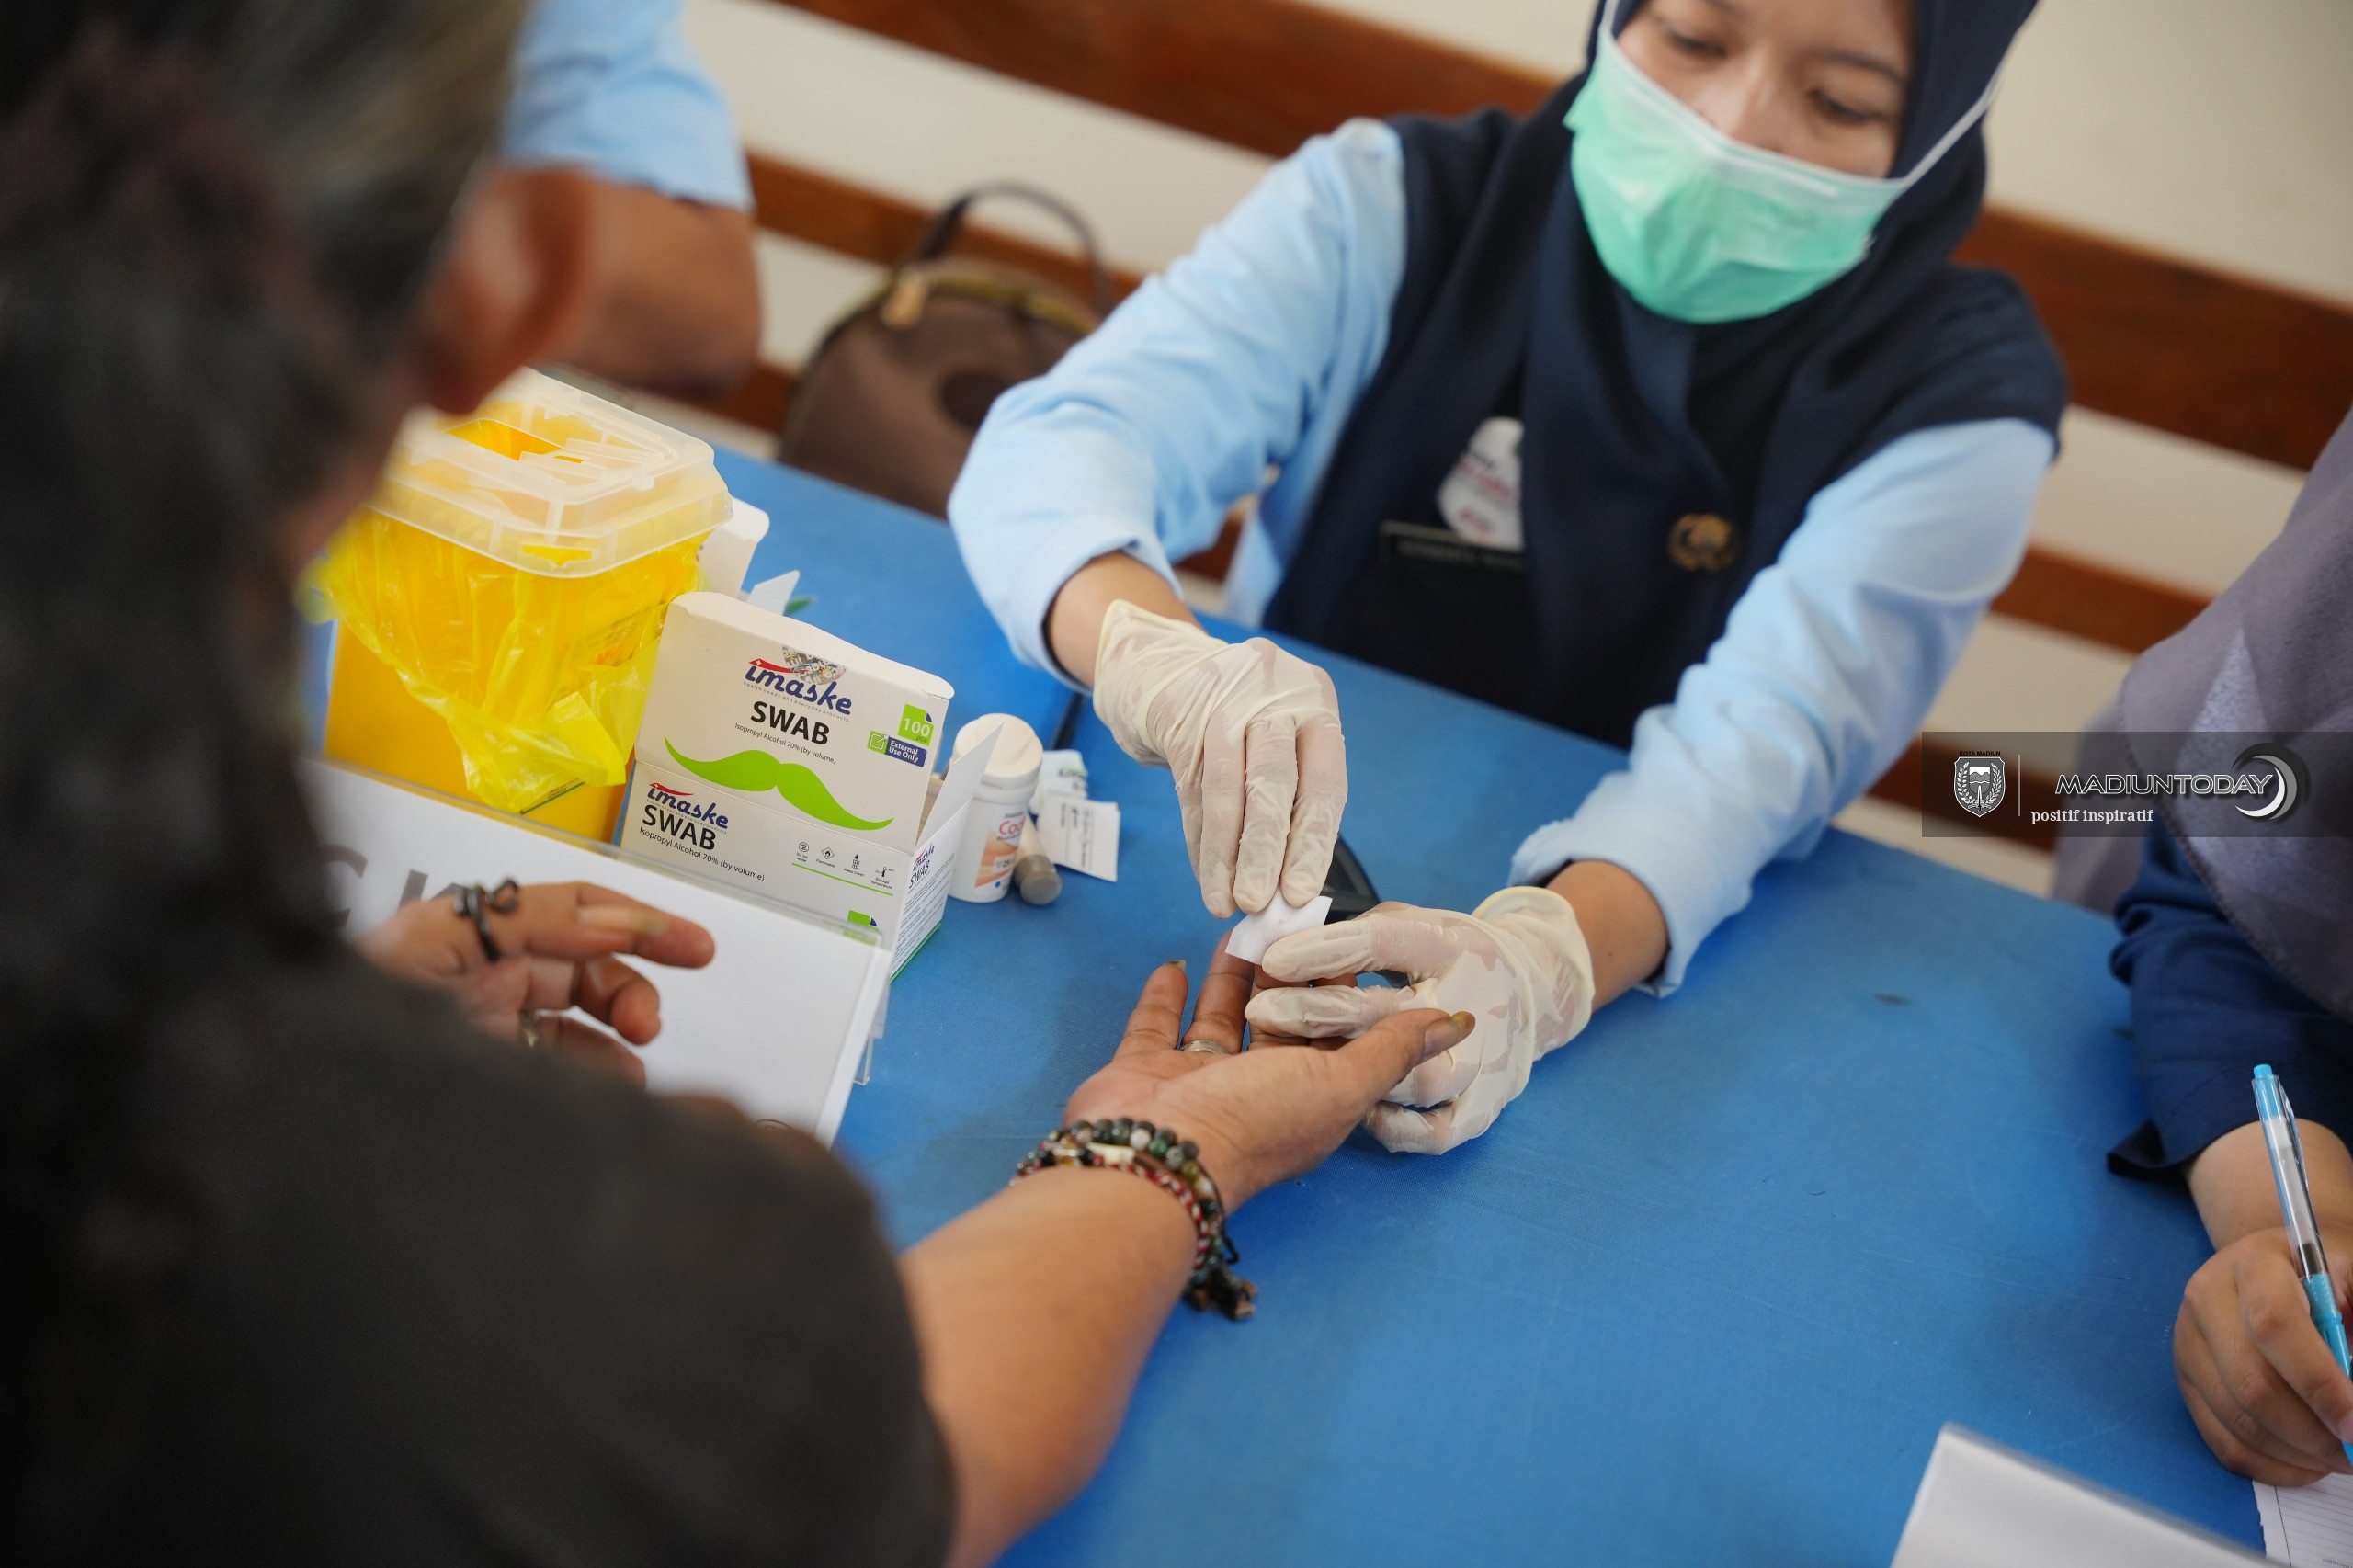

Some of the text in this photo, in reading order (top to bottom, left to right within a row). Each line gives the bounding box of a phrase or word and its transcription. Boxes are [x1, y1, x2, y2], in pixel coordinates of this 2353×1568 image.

[745, 658, 852, 715] imaske
[734, 722, 836, 765] Isopropyl Alcohol 70% (by volume)
[750, 701, 830, 745] SWAB
[904, 718, 930, 737] 100
[915, 735, 927, 744] pcs
[889, 746, 919, 764] Use Only
[890, 740, 918, 756] External
[642, 804, 716, 851] SWAB
[647, 782, 729, 830] imaske
[639, 826, 765, 882] Isopropyl Alcohol 70% (by volume)
